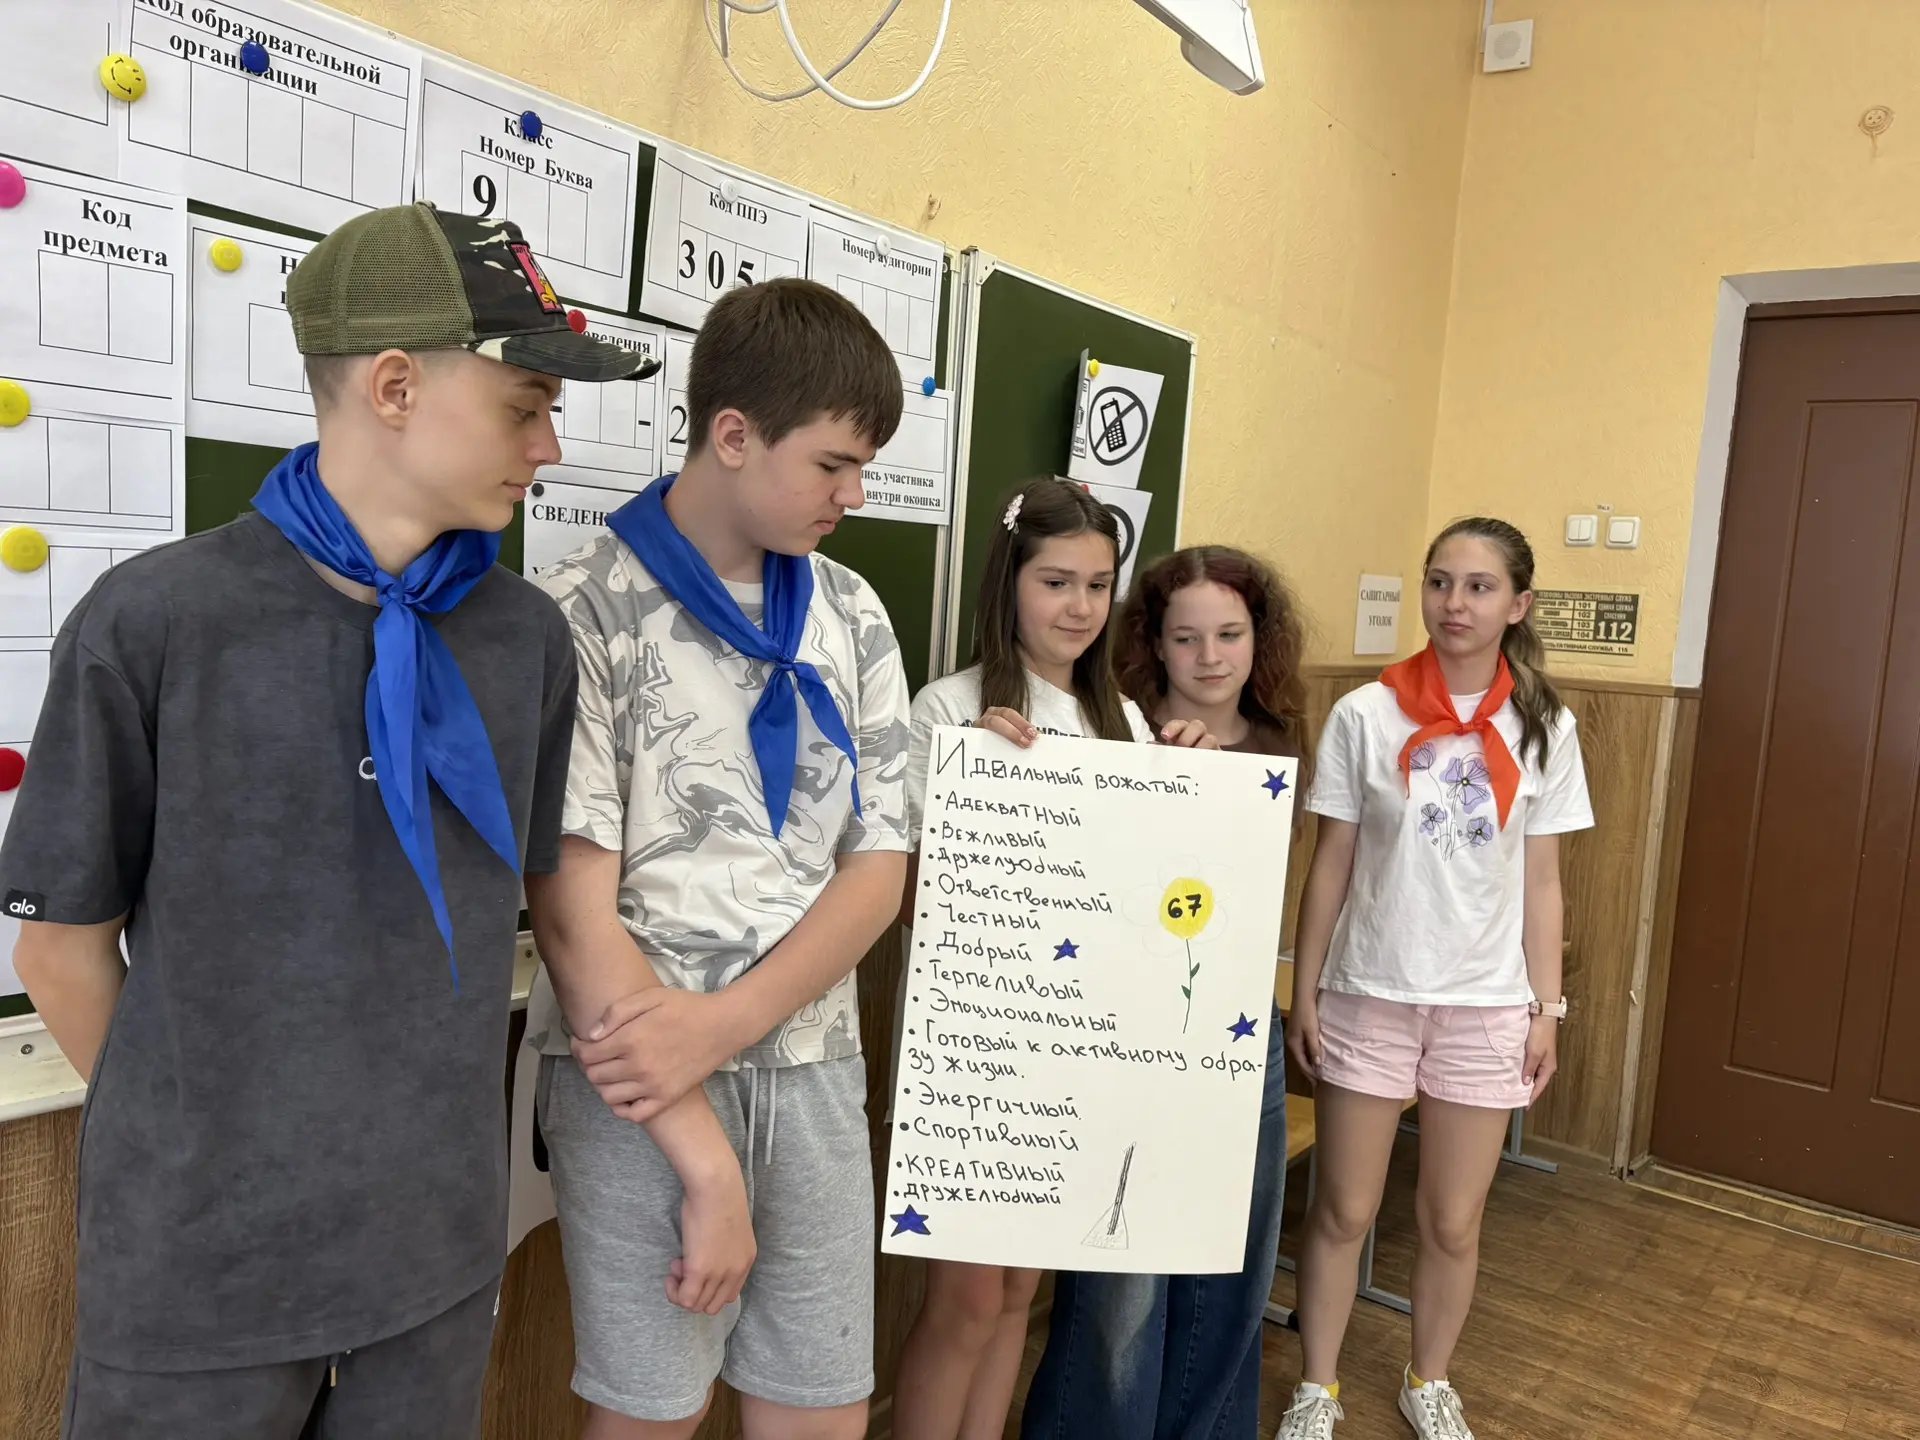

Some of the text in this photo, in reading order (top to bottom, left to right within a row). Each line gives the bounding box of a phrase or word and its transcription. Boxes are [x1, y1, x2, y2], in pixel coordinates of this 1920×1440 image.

[169, 34, 319, 96] органации
[191, 8, 382, 86] образовательной
[480, 135, 593, 189] Номер Буква
[81, 199, 132, 230] Код
[473, 174, 497, 218] 9
[709, 191, 768, 225] Код ППЭ
[43, 229, 169, 267] предмета
[842, 238, 932, 277] Номер аудитории
[669, 405, 688, 444] 2
[866, 490, 941, 508] внутри окошка
[883, 472, 934, 488] участника
[532, 503, 609, 527] СВЕДЕН
[1596, 621, 1633, 642] 112
[9, 898, 36, 915] alo
[938, 872, 1113, 914] Ответственный
[1168, 893, 1202, 919] 67
[937, 902, 1041, 930] Честный
[936, 930, 1033, 968] Добрый
[928, 958, 1084, 1000] Терпеливый
[929, 987, 1117, 1032] Эмоциональный
[926, 1019, 1018, 1053] Готовый
[1027, 1038, 1042, 1053] к
[1051, 1040, 1188, 1072] активному
[914, 1116, 1079, 1151] Спортивный
